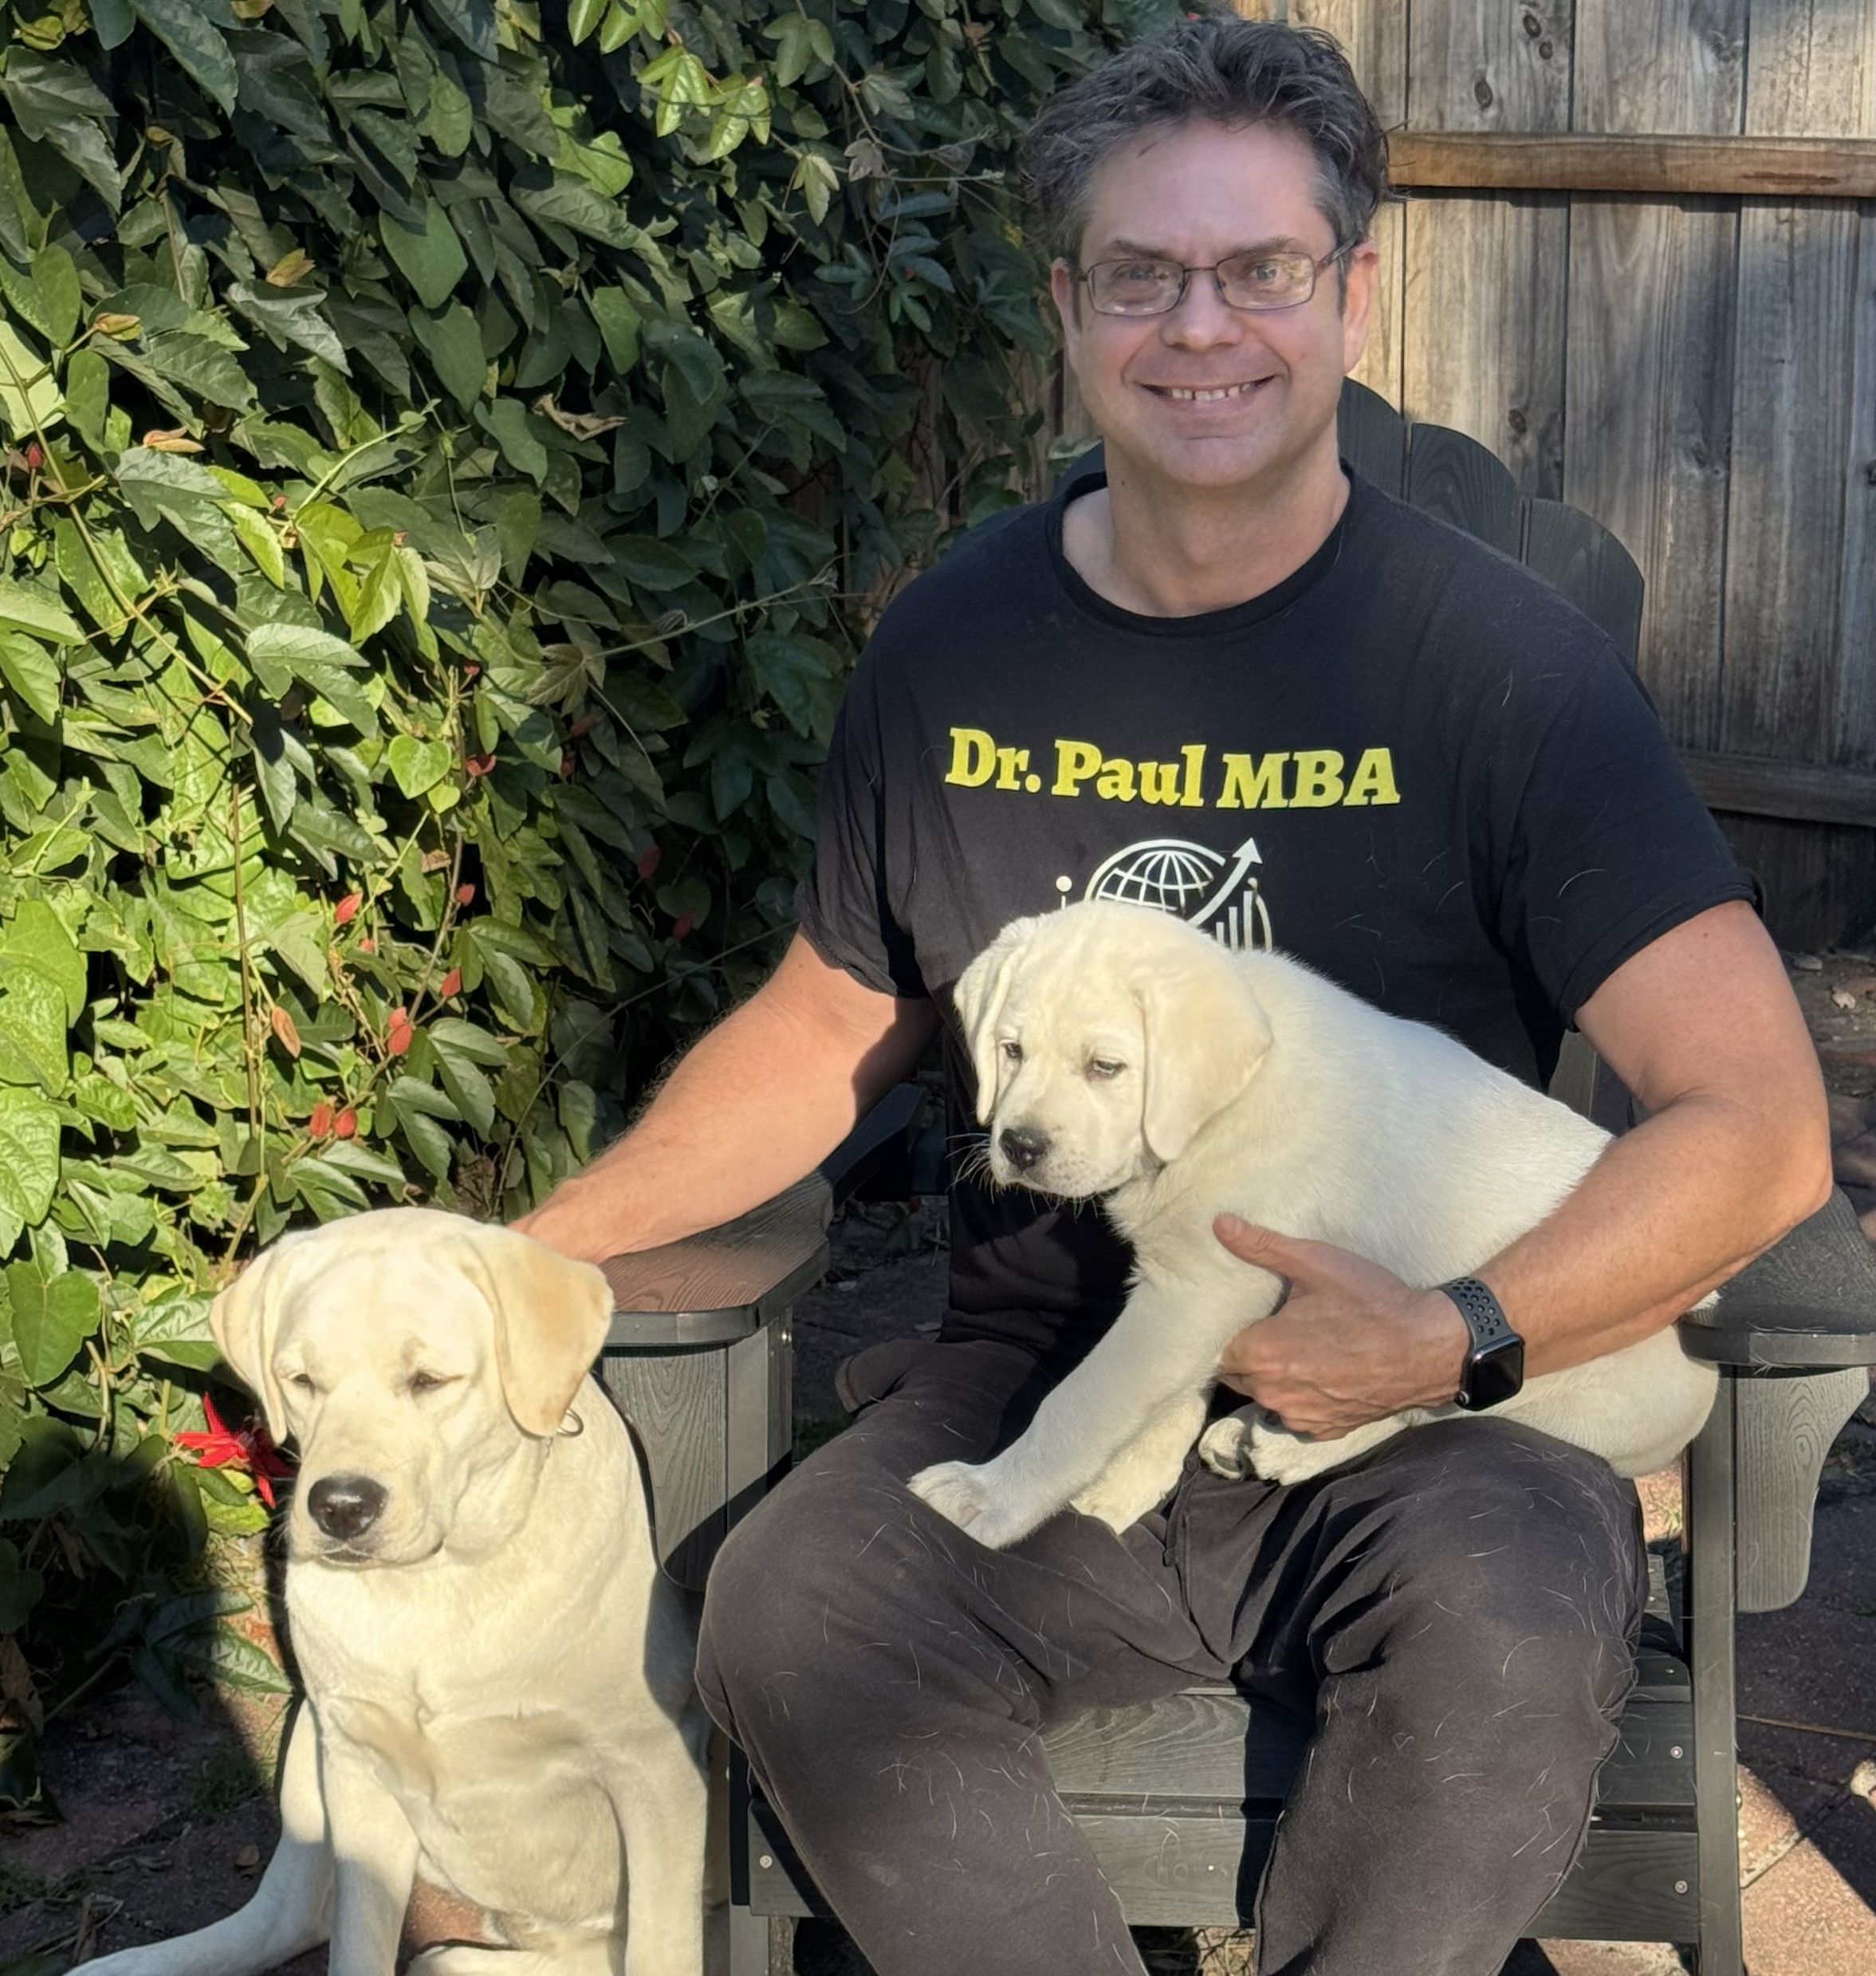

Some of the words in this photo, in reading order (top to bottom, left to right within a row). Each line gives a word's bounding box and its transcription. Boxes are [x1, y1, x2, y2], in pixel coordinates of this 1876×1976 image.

[945, 727, 1041, 793] Dr.
[1051, 739, 1207, 808] Paul
[1216, 747, 1402, 809] MBA
